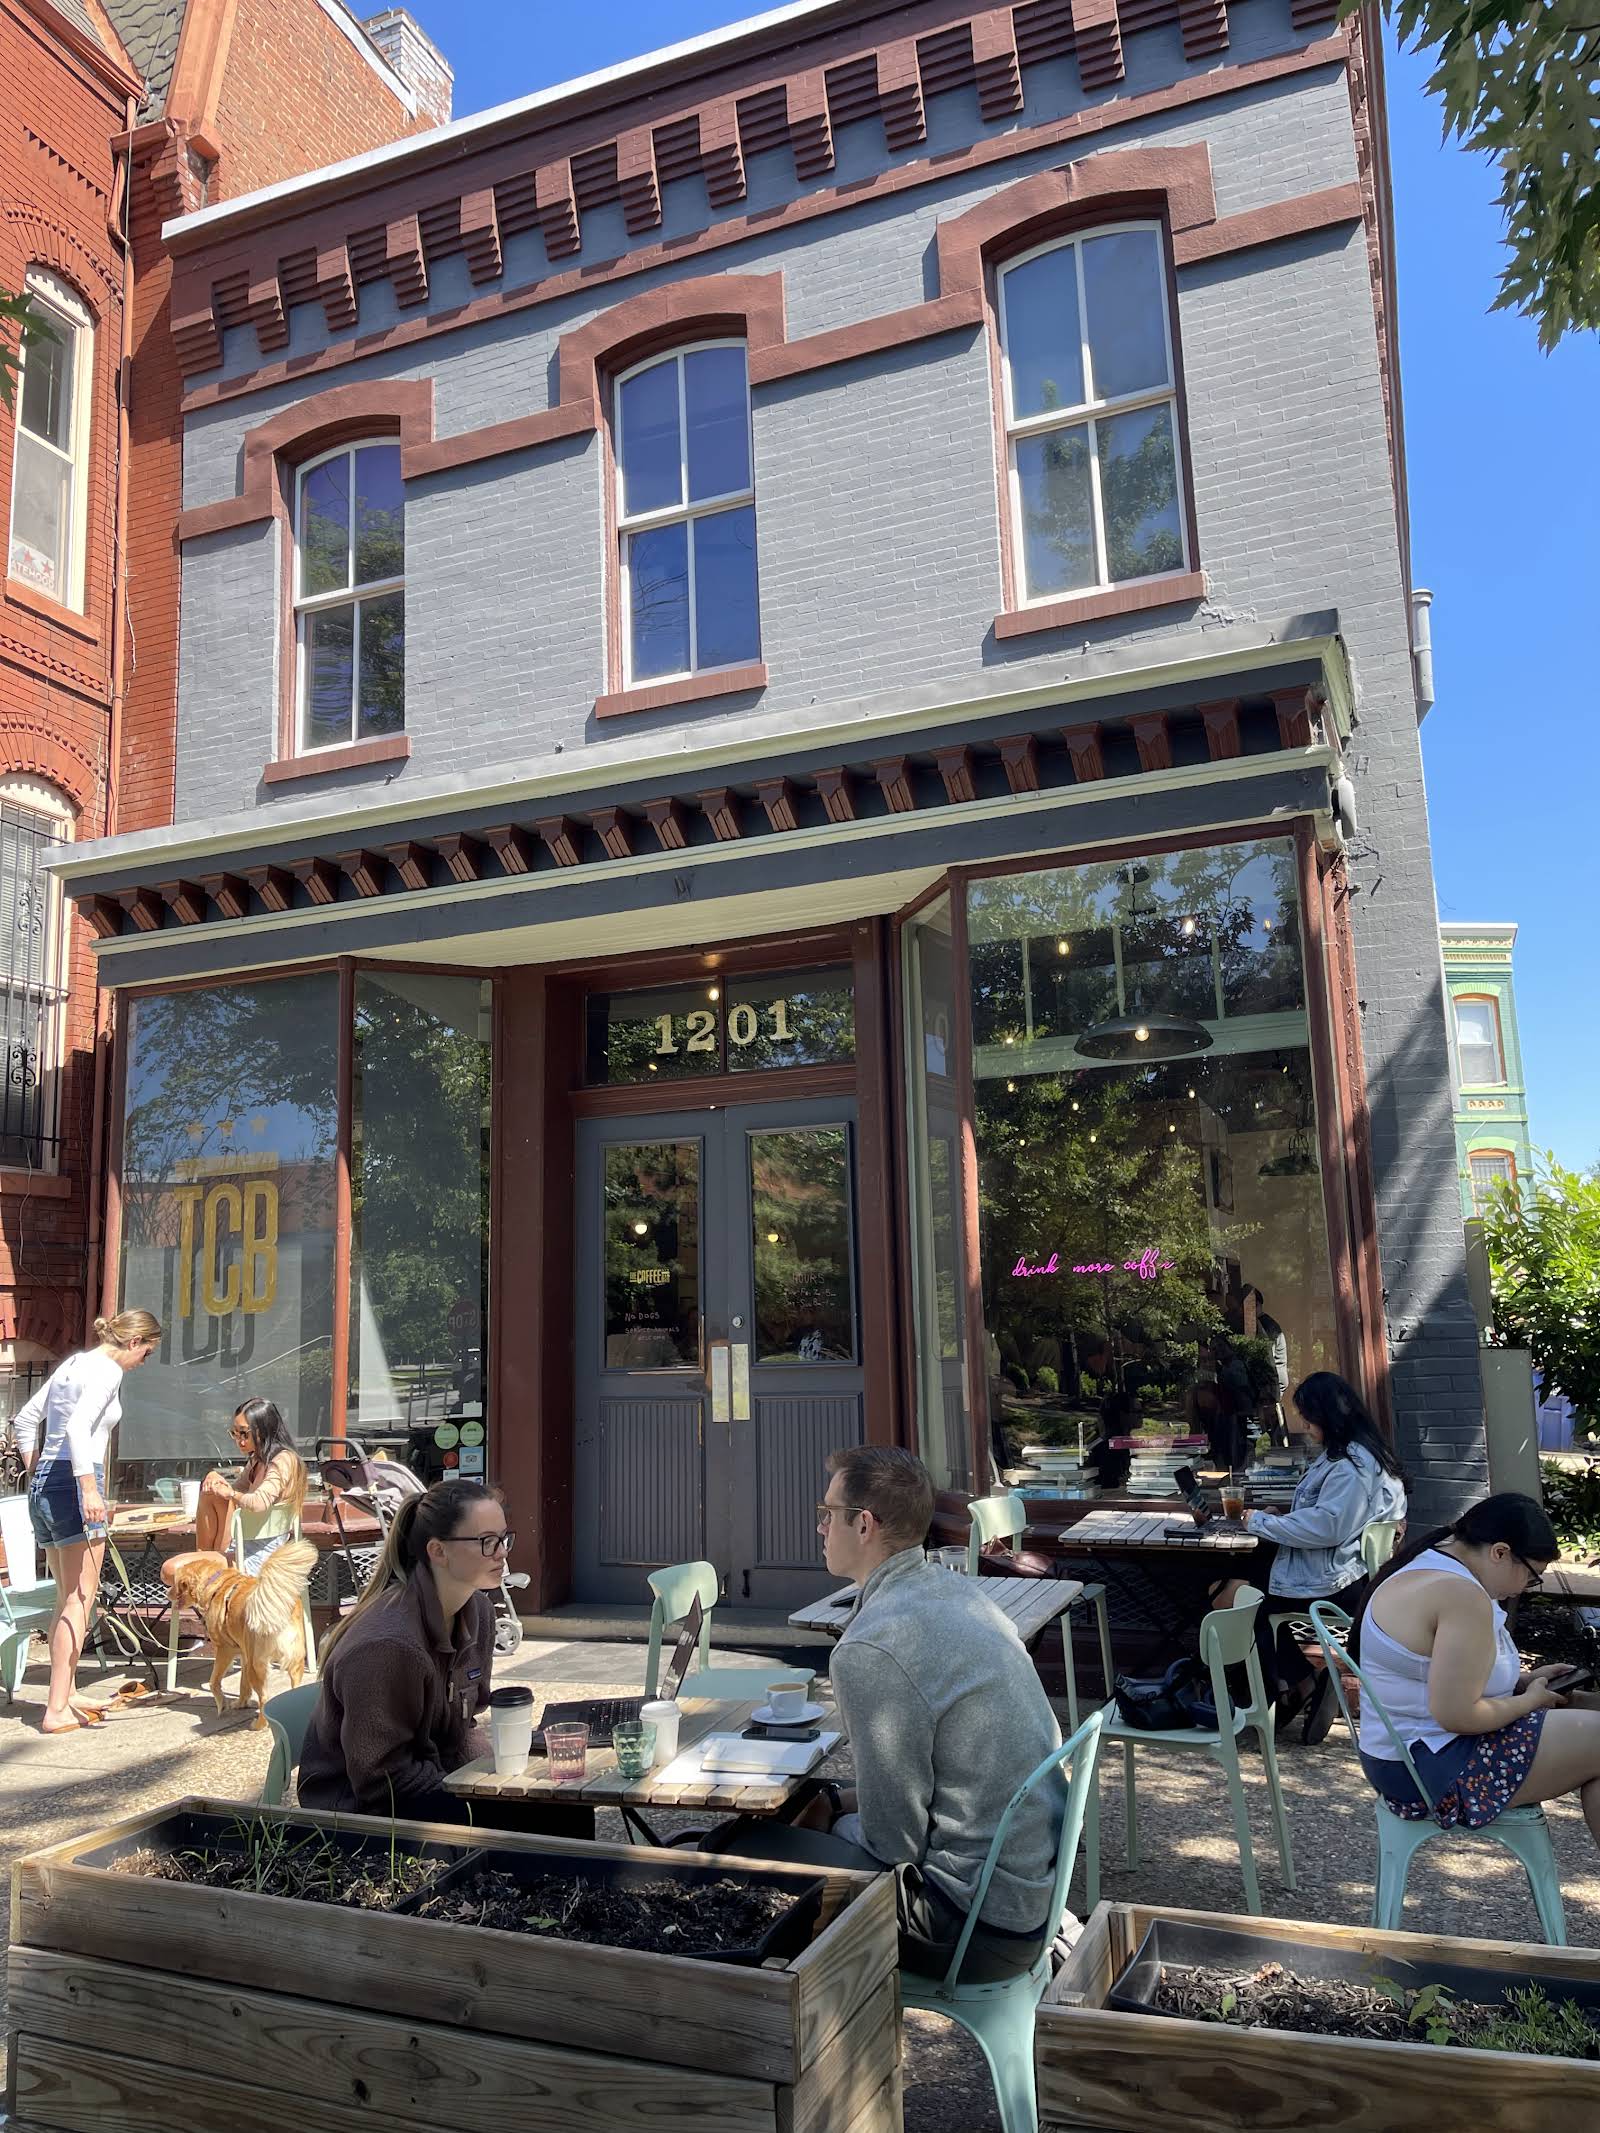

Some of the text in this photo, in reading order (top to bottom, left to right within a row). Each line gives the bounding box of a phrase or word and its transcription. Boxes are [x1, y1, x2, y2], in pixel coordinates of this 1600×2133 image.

[655, 999, 794, 1054] 1201
[174, 1180, 279, 1317] TCB
[1012, 1252, 1060, 1278] drink
[1072, 1263, 1116, 1274] more
[637, 1268, 661, 1284] COFFEE
